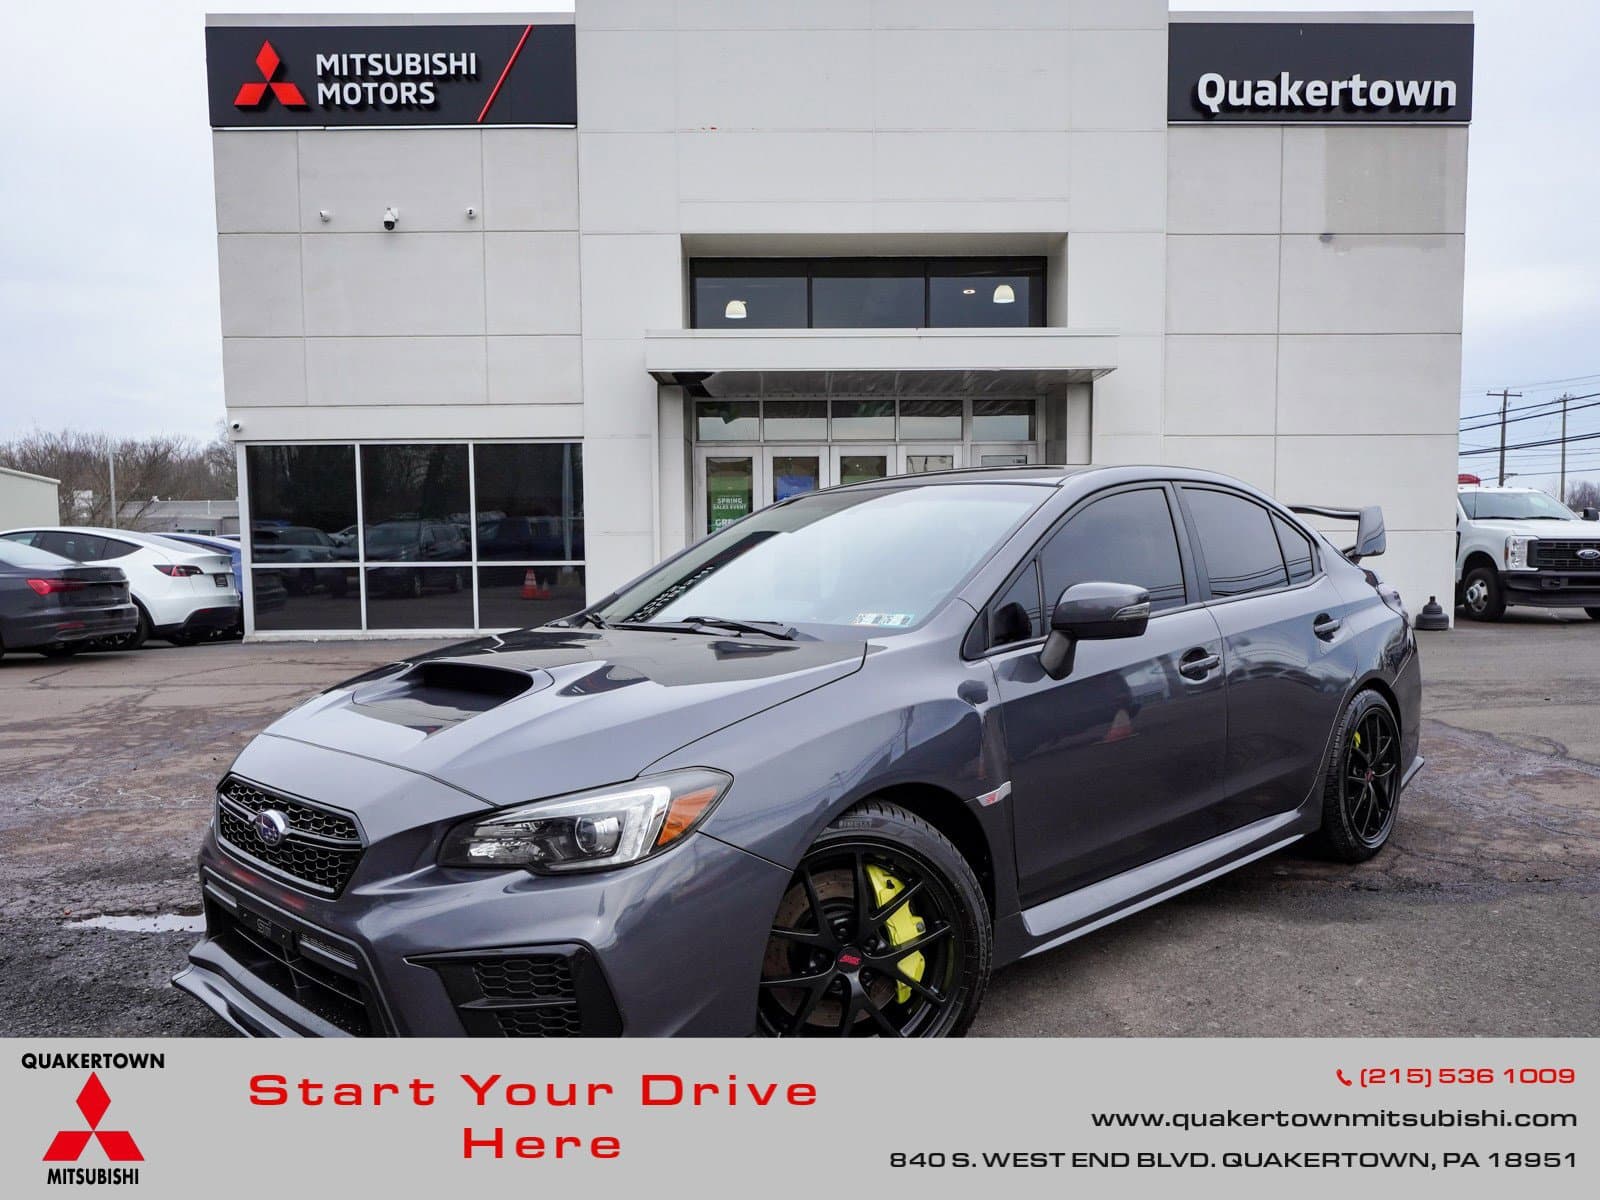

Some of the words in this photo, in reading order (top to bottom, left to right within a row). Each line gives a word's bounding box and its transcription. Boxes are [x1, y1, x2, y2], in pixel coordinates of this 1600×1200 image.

[316, 52, 477, 77] MITSUBISHI
[317, 81, 436, 106] MOTORS
[1197, 71, 1458, 113] Quakertown
